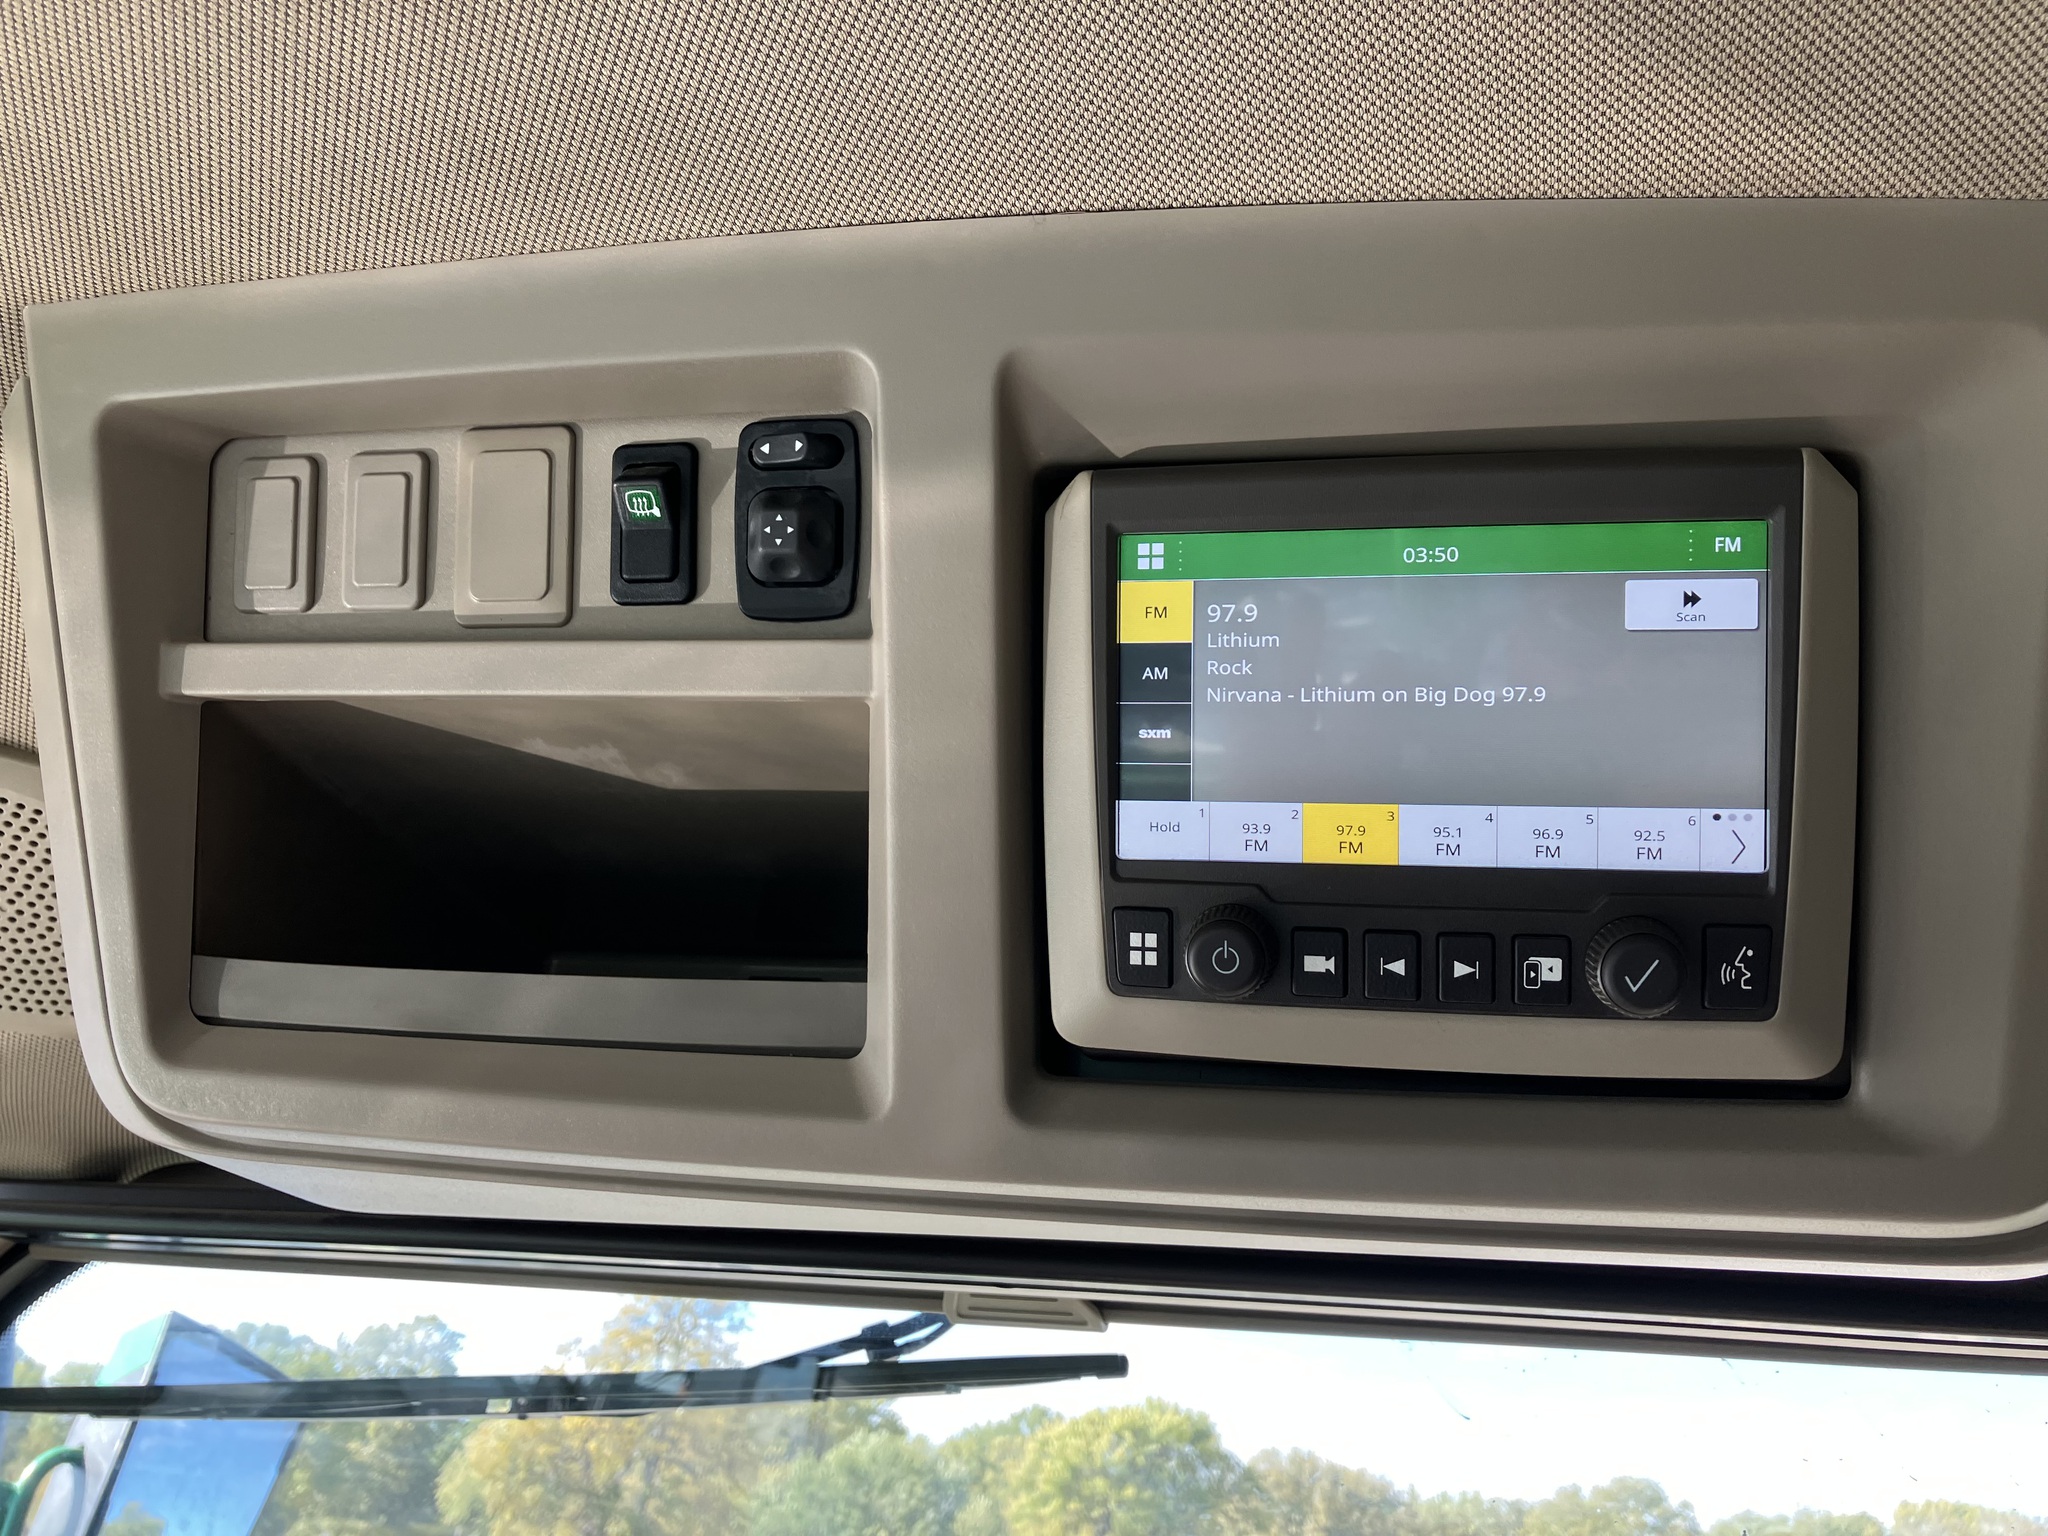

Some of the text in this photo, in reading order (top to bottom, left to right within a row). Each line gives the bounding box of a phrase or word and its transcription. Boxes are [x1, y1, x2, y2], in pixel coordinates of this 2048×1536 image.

[1714, 536, 1742, 553] FM
[1402, 546, 1459, 563] 03:50
[1144, 606, 1168, 619] FM
[1207, 603, 1258, 623] 97.9
[1675, 612, 1706, 622] Scan
[1206, 632, 1280, 648] Lithium
[1206, 659, 1253, 675] Rock
[1141, 667, 1169, 680] AM
[1206, 687, 1282, 703] Nirvana
[1300, 686, 1375, 703] Lithium
[1382, 689, 1407, 703] on
[1414, 686, 1447, 707] Big
[1454, 686, 1496, 707] Dog
[1502, 686, 1546, 703] 97.9
[1138, 728, 1171, 739] sxm
[1199, 808, 1205, 818] 1
[1291, 809, 1299, 820] 2
[1386, 811, 1395, 821] 3
[1485, 813, 1494, 823] 4
[1585, 814, 1594, 825] 5
[1688, 815, 1697, 826] 6
[1149, 822, 1181, 833] Hold
[1242, 823, 1271, 835] 93.9
[1336, 825, 1366, 837] 97.9
[1433, 827, 1462, 838] 95.1
[1532, 828, 1564, 840] 96.9
[1634, 830, 1666, 842] 92.5
[1244, 839, 1269, 852] FM
[1338, 841, 1364, 855] FM
[1436, 843, 1461, 857] FM
[1535, 845, 1561, 859] FM
[1636, 847, 1663, 860] FM
